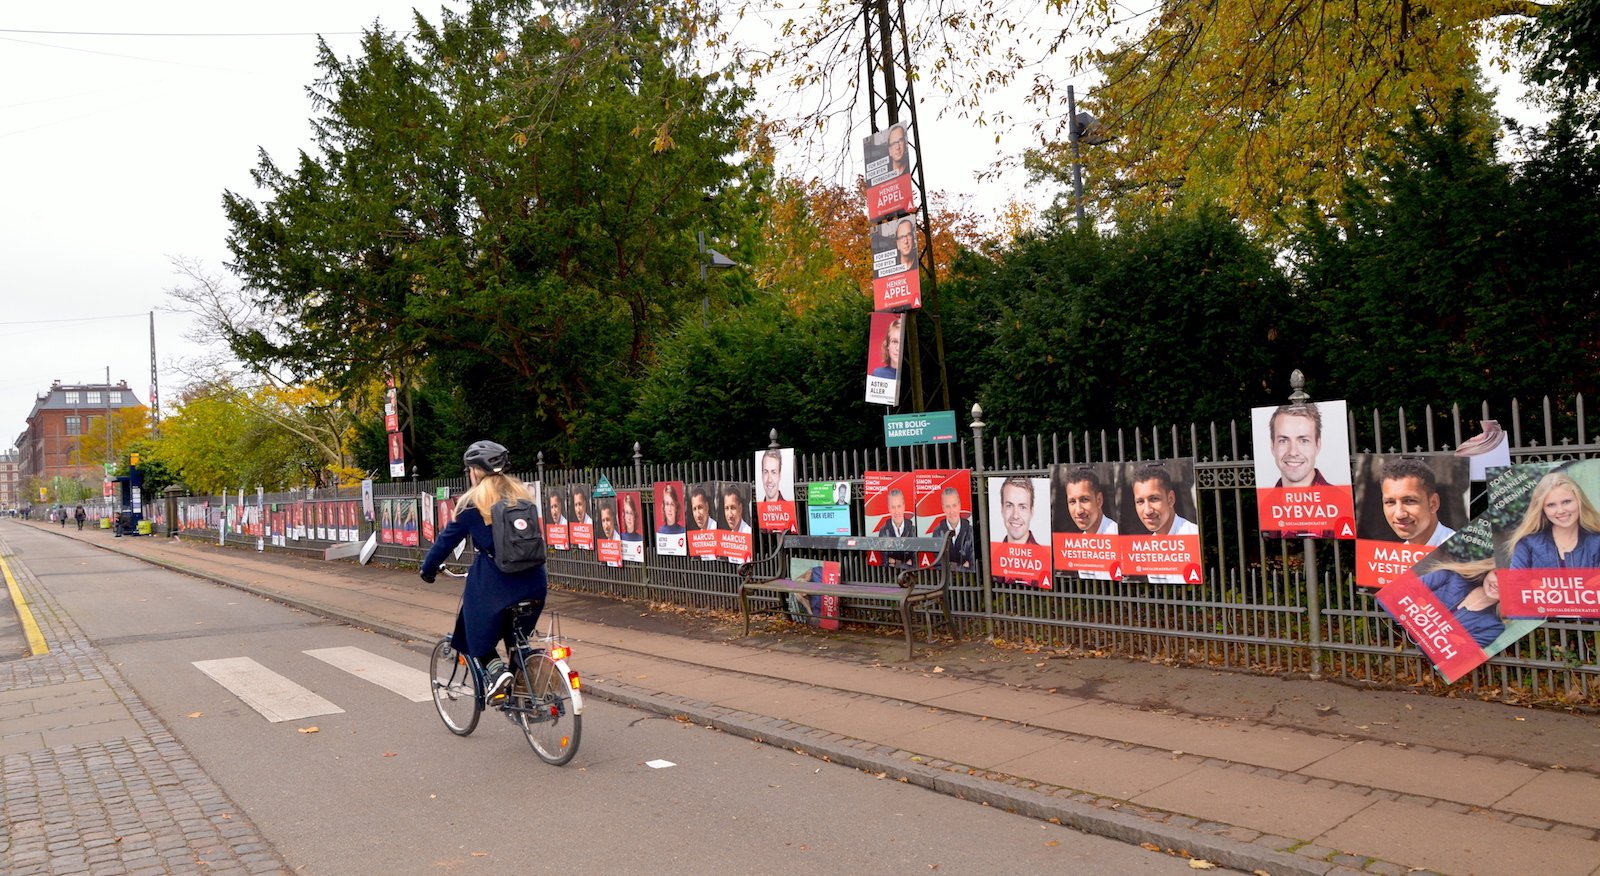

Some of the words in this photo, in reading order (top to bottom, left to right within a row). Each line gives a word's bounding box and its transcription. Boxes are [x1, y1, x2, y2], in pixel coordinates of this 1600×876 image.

[879, 184, 900, 196] HENRIK
[877, 190, 904, 209] APPEL
[886, 278, 907, 289] HENRIK
[884, 284, 912, 300] APPEL
[887, 422, 904, 430] STYR
[904, 420, 931, 429] BOLIG-
[888, 428, 924, 438] MARKEDET
[1489, 474, 1505, 488] FOR
[1503, 469, 1513, 478] ET
[1285, 492, 1320, 503] RUNE
[762, 512, 790, 522] DYBVAD
[1271, 504, 1339, 519] DYBVAD
[1340, 522, 1354, 536] A
[692, 532, 715, 540] MARCUS
[722, 534, 746, 543] MARCUS
[692, 540, 718, 548] VESTERAGER
[720, 542, 749, 550] VESTERAGER
[1064, 538, 1112, 549] MARCUS
[1132, 539, 1186, 551] MARCUS
[868, 551, 878, 563] A
[1009, 547, 1033, 557] RUNE
[1061, 550, 1117, 560] VESTERAGER
[1128, 553, 1191, 562] VESTERAGER
[1374, 547, 1430, 564] MARC
[921, 553, 931, 566] A
[1000, 556, 1043, 571] DYBVAD
[1189, 568, 1200, 581] A
[1042, 575, 1051, 587] A
[1540, 577, 1585, 589] JULIE
[1420, 603, 1454, 636] JULIE
[1397, 595, 1458, 660] FRØLICH
